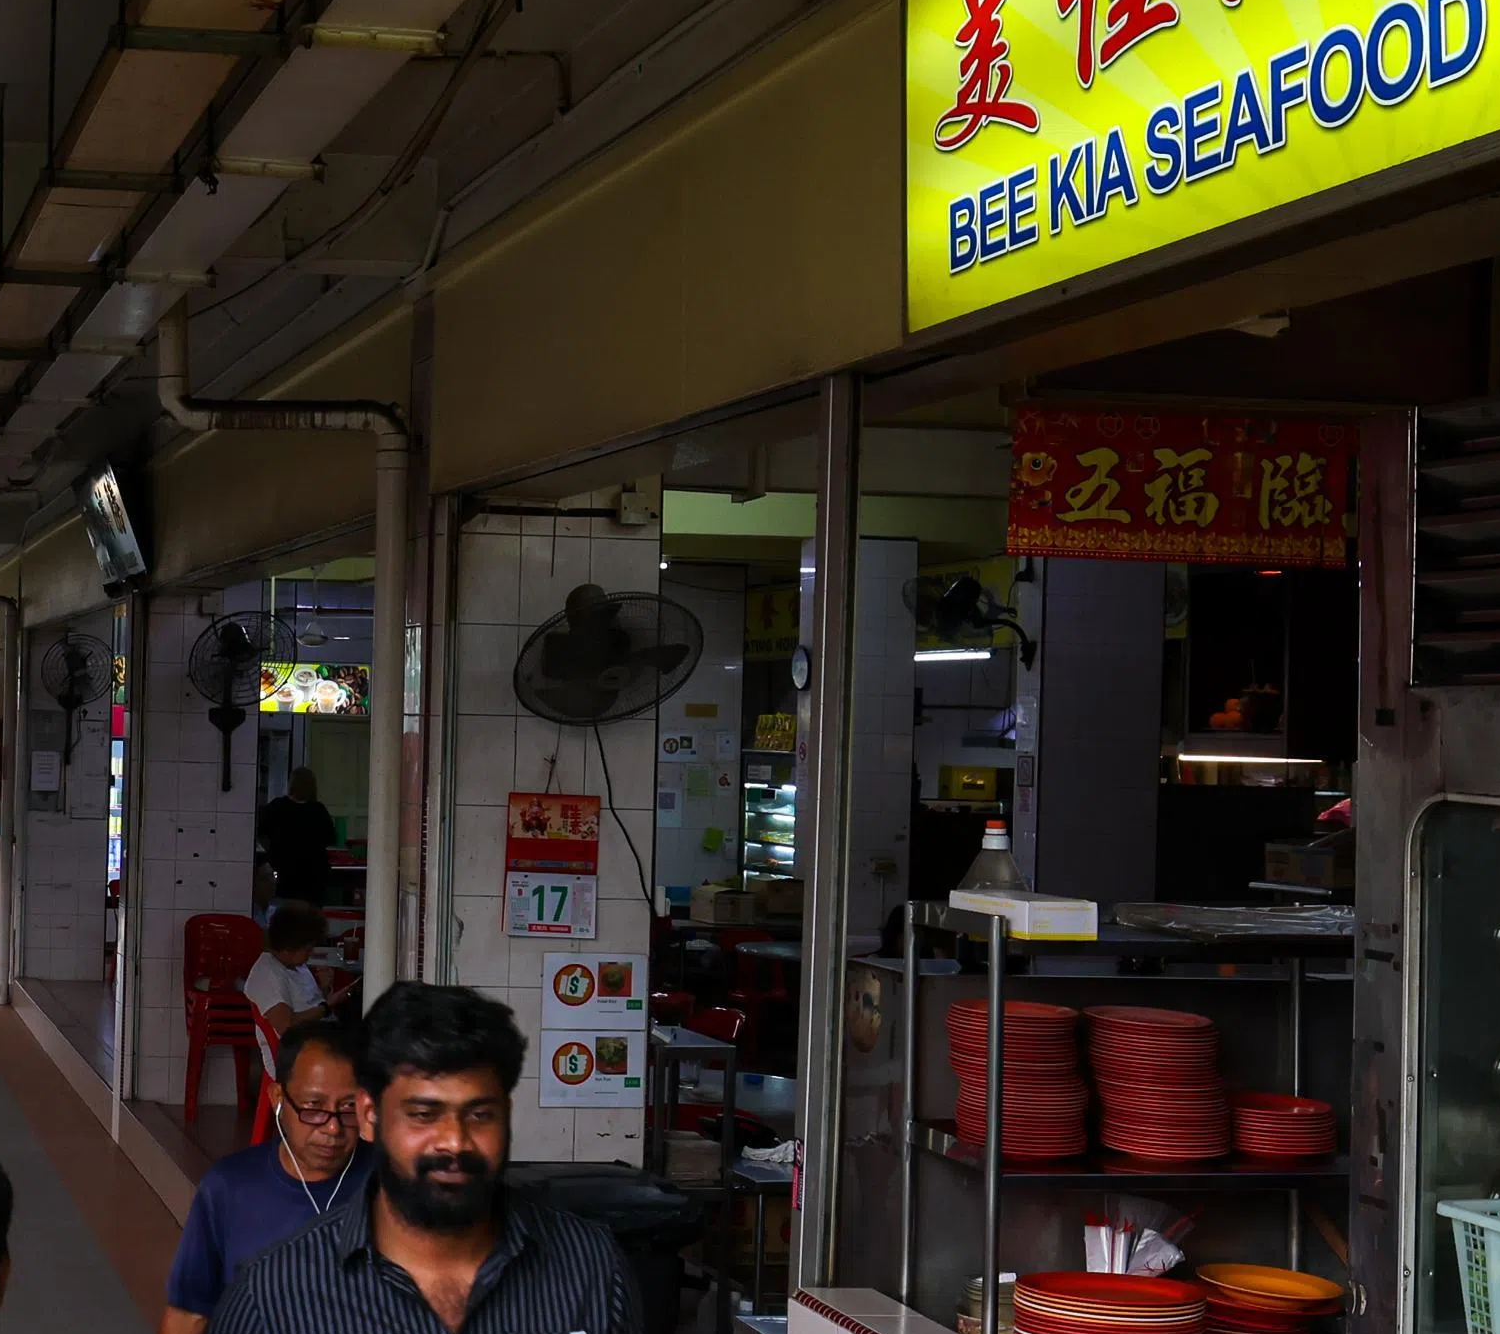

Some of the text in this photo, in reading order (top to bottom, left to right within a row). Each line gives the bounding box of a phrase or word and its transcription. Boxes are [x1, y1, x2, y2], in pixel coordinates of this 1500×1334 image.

[948, 163, 1039, 274] BEE
[1048, 126, 1138, 234] KIA
[1056, 446, 1357, 533] 五福臨
[531, 884, 568, 922] 17
